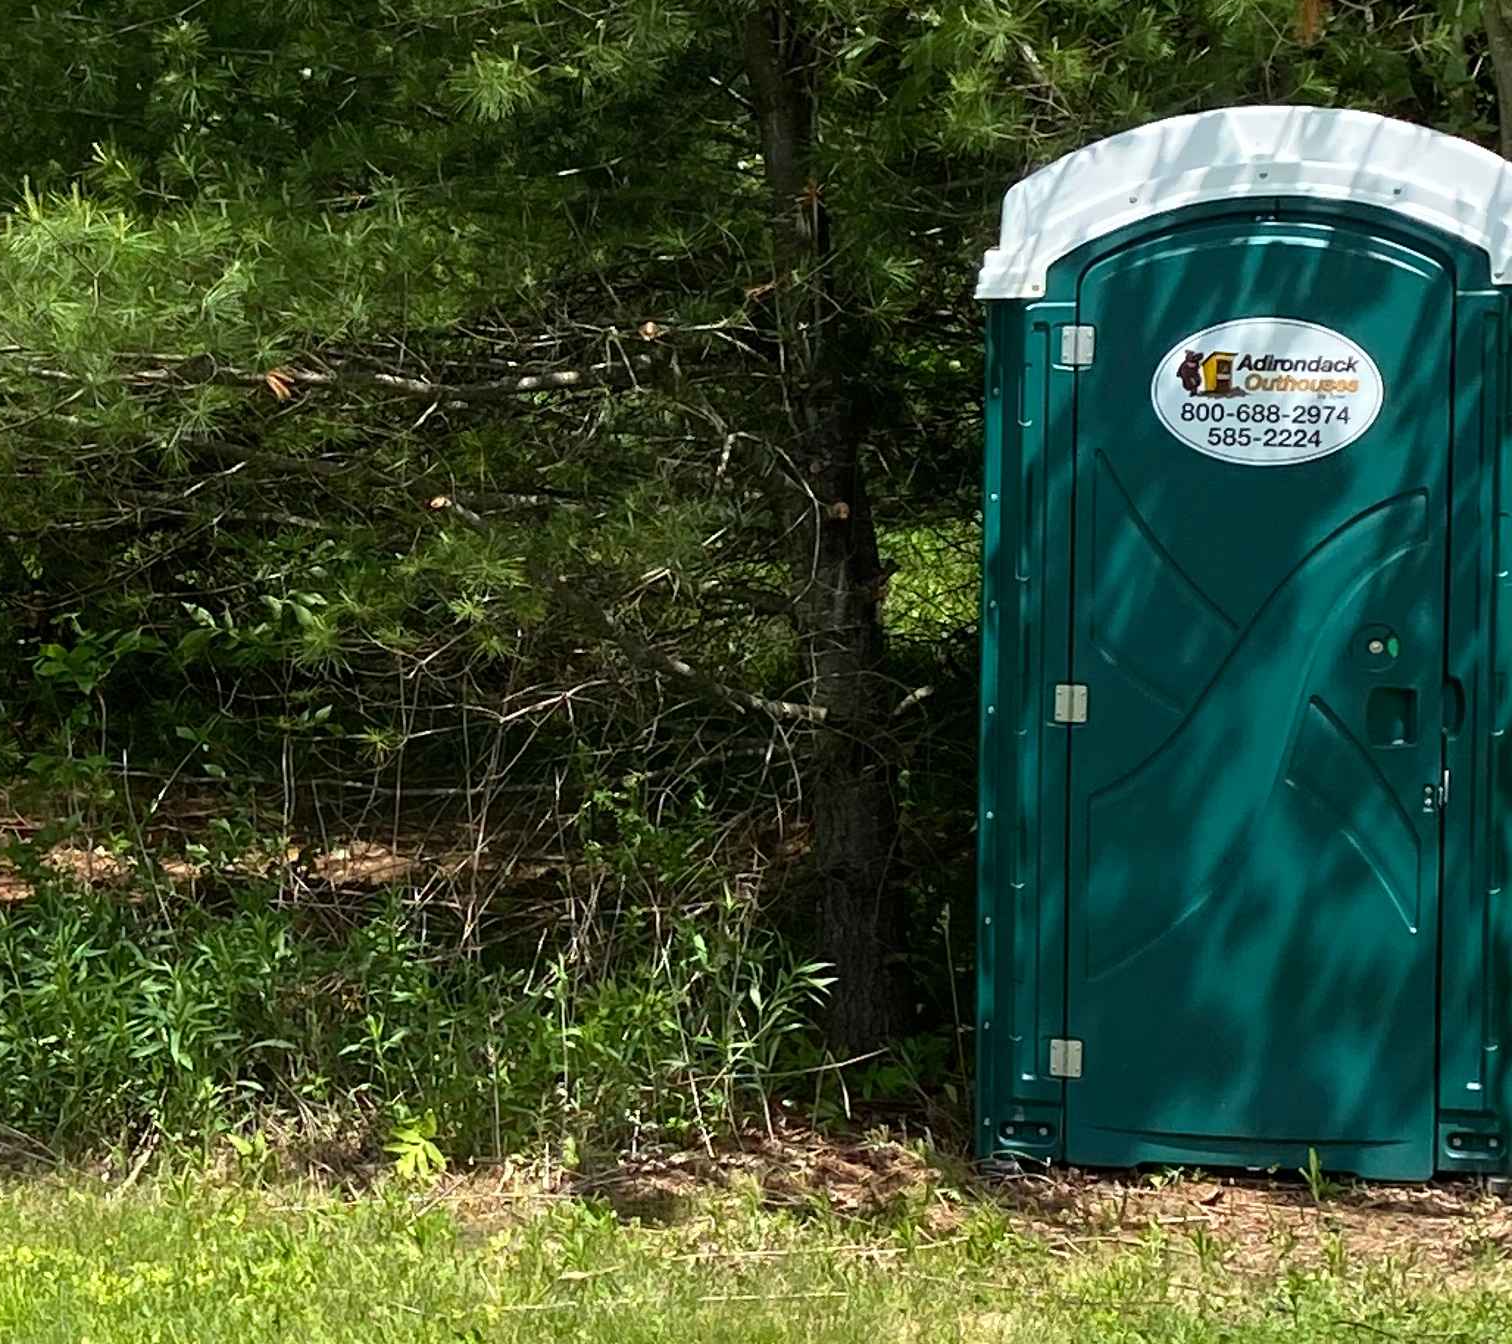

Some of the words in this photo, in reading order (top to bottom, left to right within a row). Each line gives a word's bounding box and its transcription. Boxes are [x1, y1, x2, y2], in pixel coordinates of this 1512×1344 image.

[1237, 354, 1359, 373] Adirondack
[1245, 373, 1359, 393] Outhouses
[1180, 403, 1350, 424] 800-688-2974
[1207, 428, 1322, 447] 585-2224
